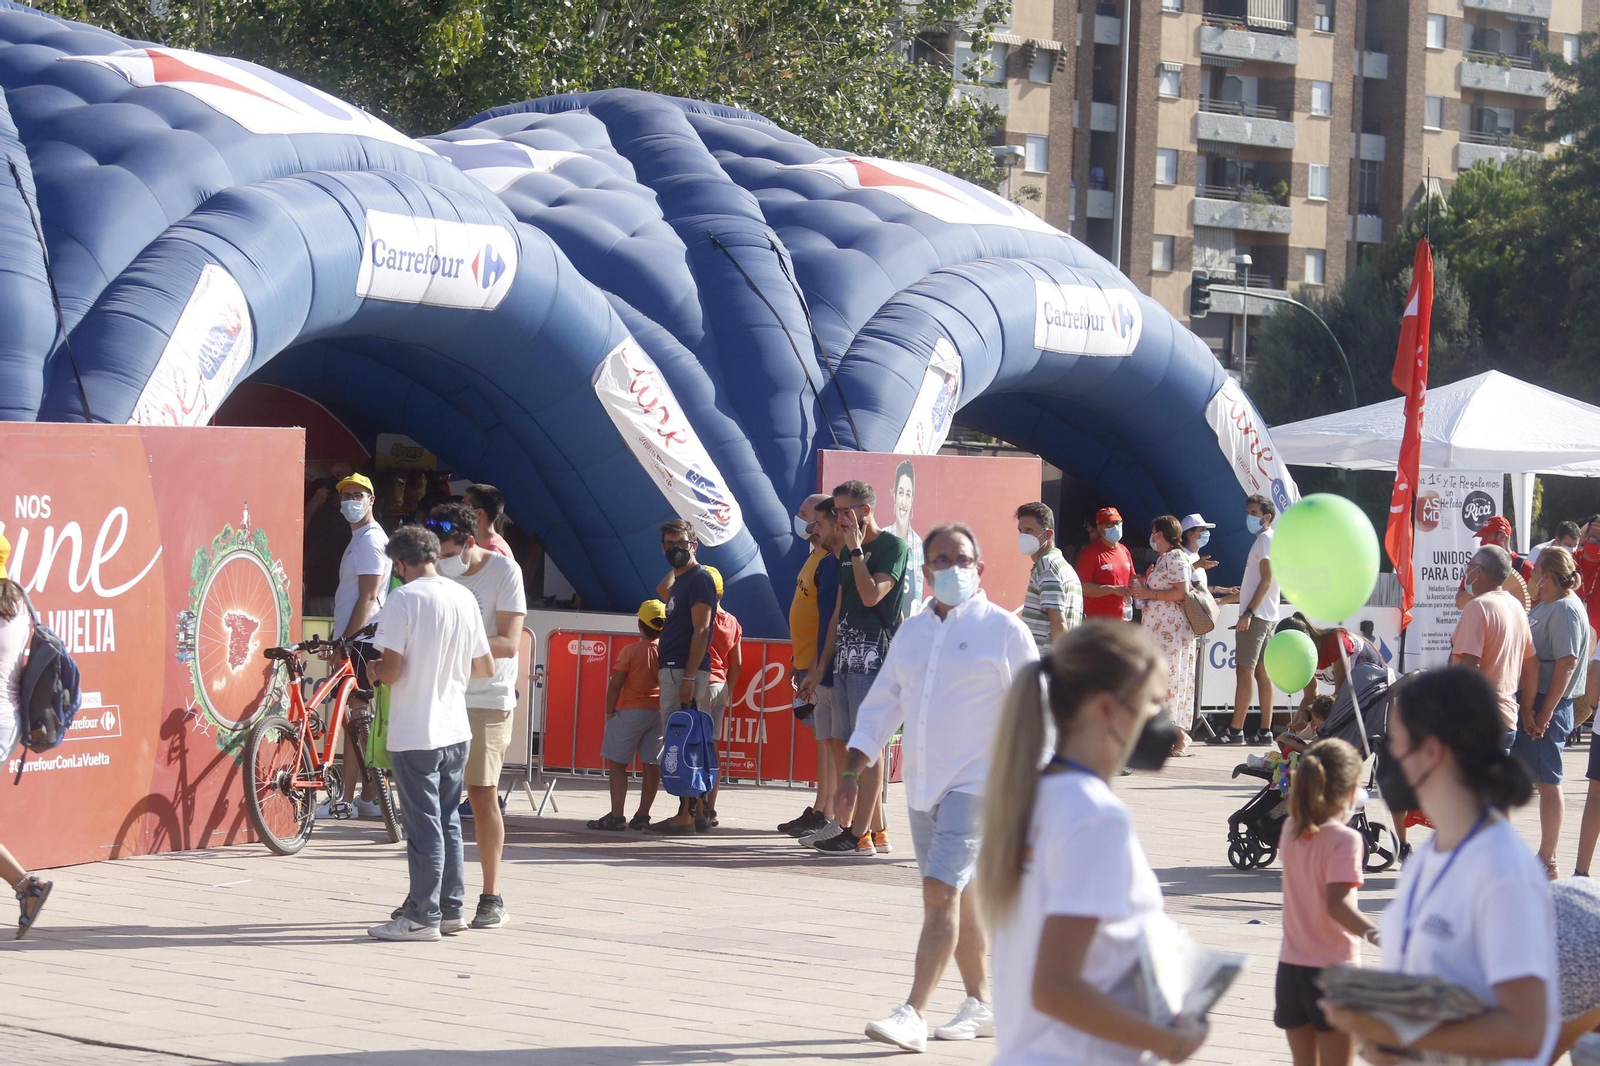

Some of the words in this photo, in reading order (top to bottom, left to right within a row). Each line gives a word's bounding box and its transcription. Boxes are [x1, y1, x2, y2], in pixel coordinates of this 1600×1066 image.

[371, 238, 464, 279] Carrefour
[1043, 301, 1105, 332] Carrefour
[1459, 475, 1500, 489] Regalamos
[15, 494, 51, 519] NOS
[1440, 498, 1463, 508] Helado
[1464, 501, 1492, 522] Ricci
[1423, 510, 1441, 522] MD
[1433, 551, 1472, 565] UNIDOS
[1421, 566, 1449, 581] PARA
[48, 608, 115, 654] VUELTA
